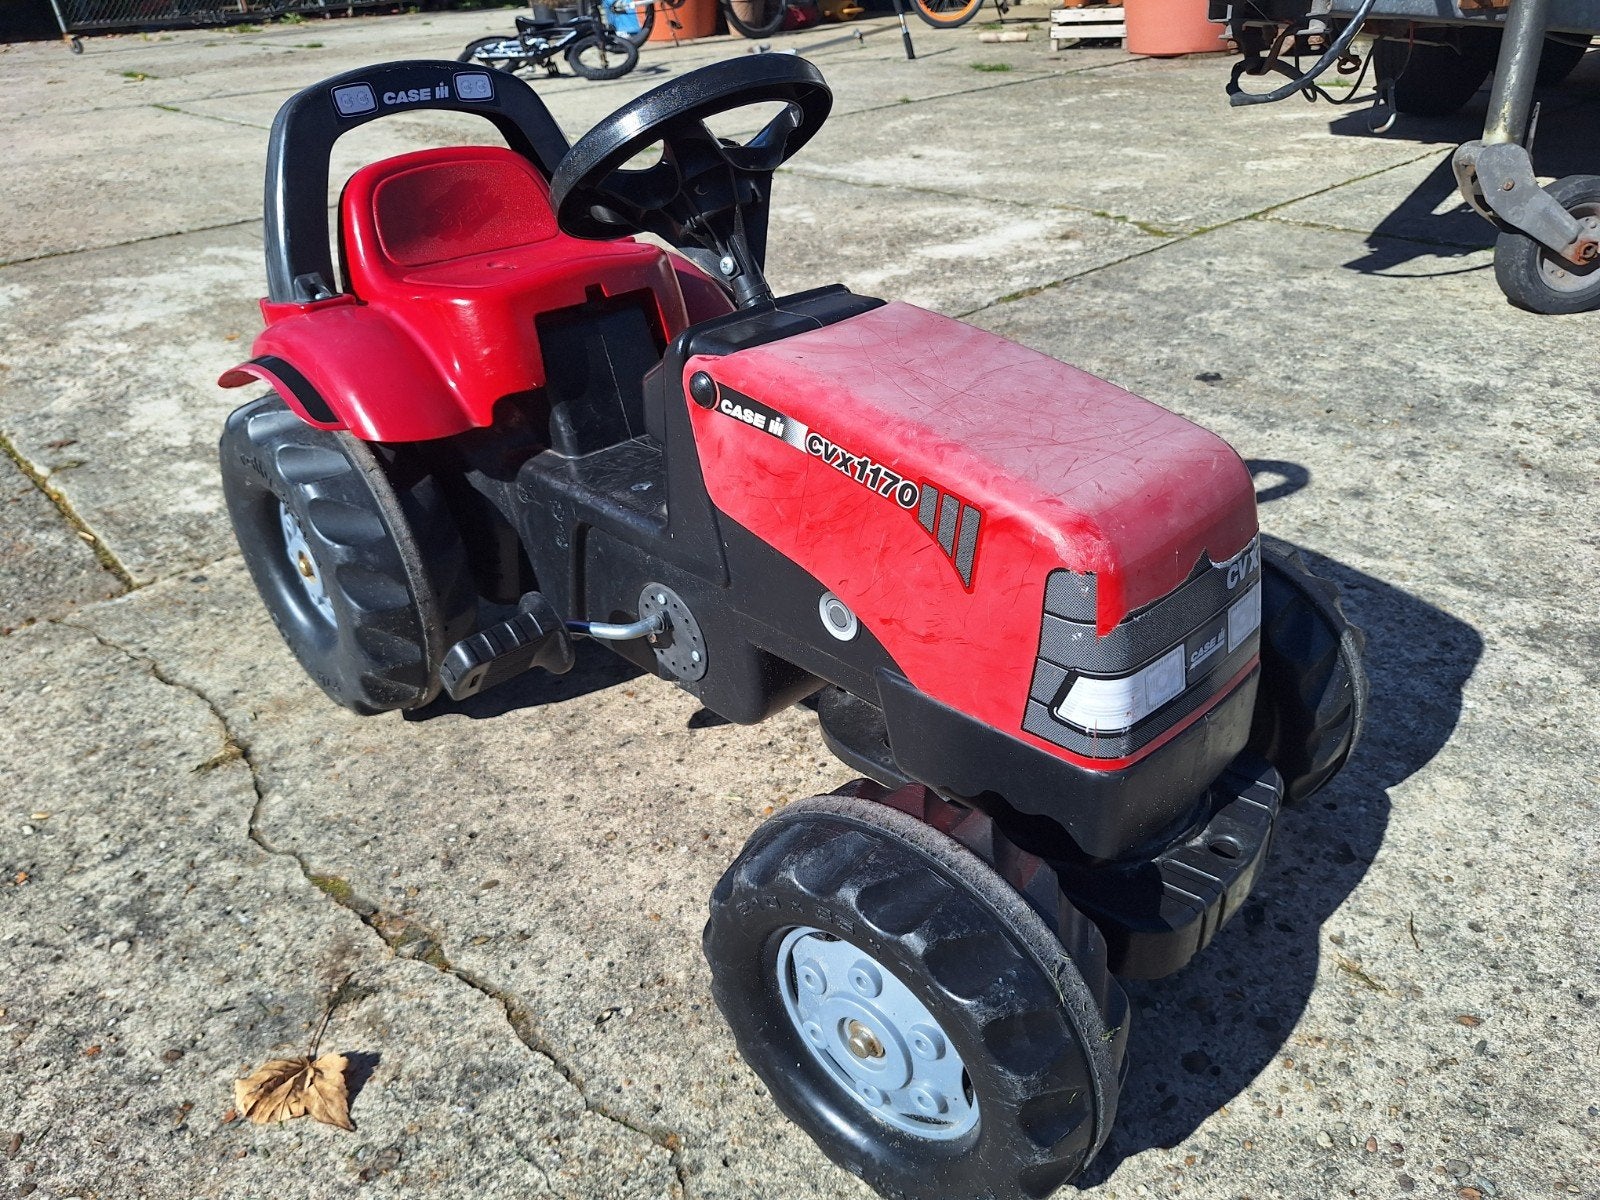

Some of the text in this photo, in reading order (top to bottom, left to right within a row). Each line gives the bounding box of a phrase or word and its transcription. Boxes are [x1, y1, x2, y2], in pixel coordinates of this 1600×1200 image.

[383, 88, 431, 105] CASE
[720, 399, 765, 429] CASE
[807, 433, 920, 508] CVX1170
[1190, 636, 1217, 663] CASE
